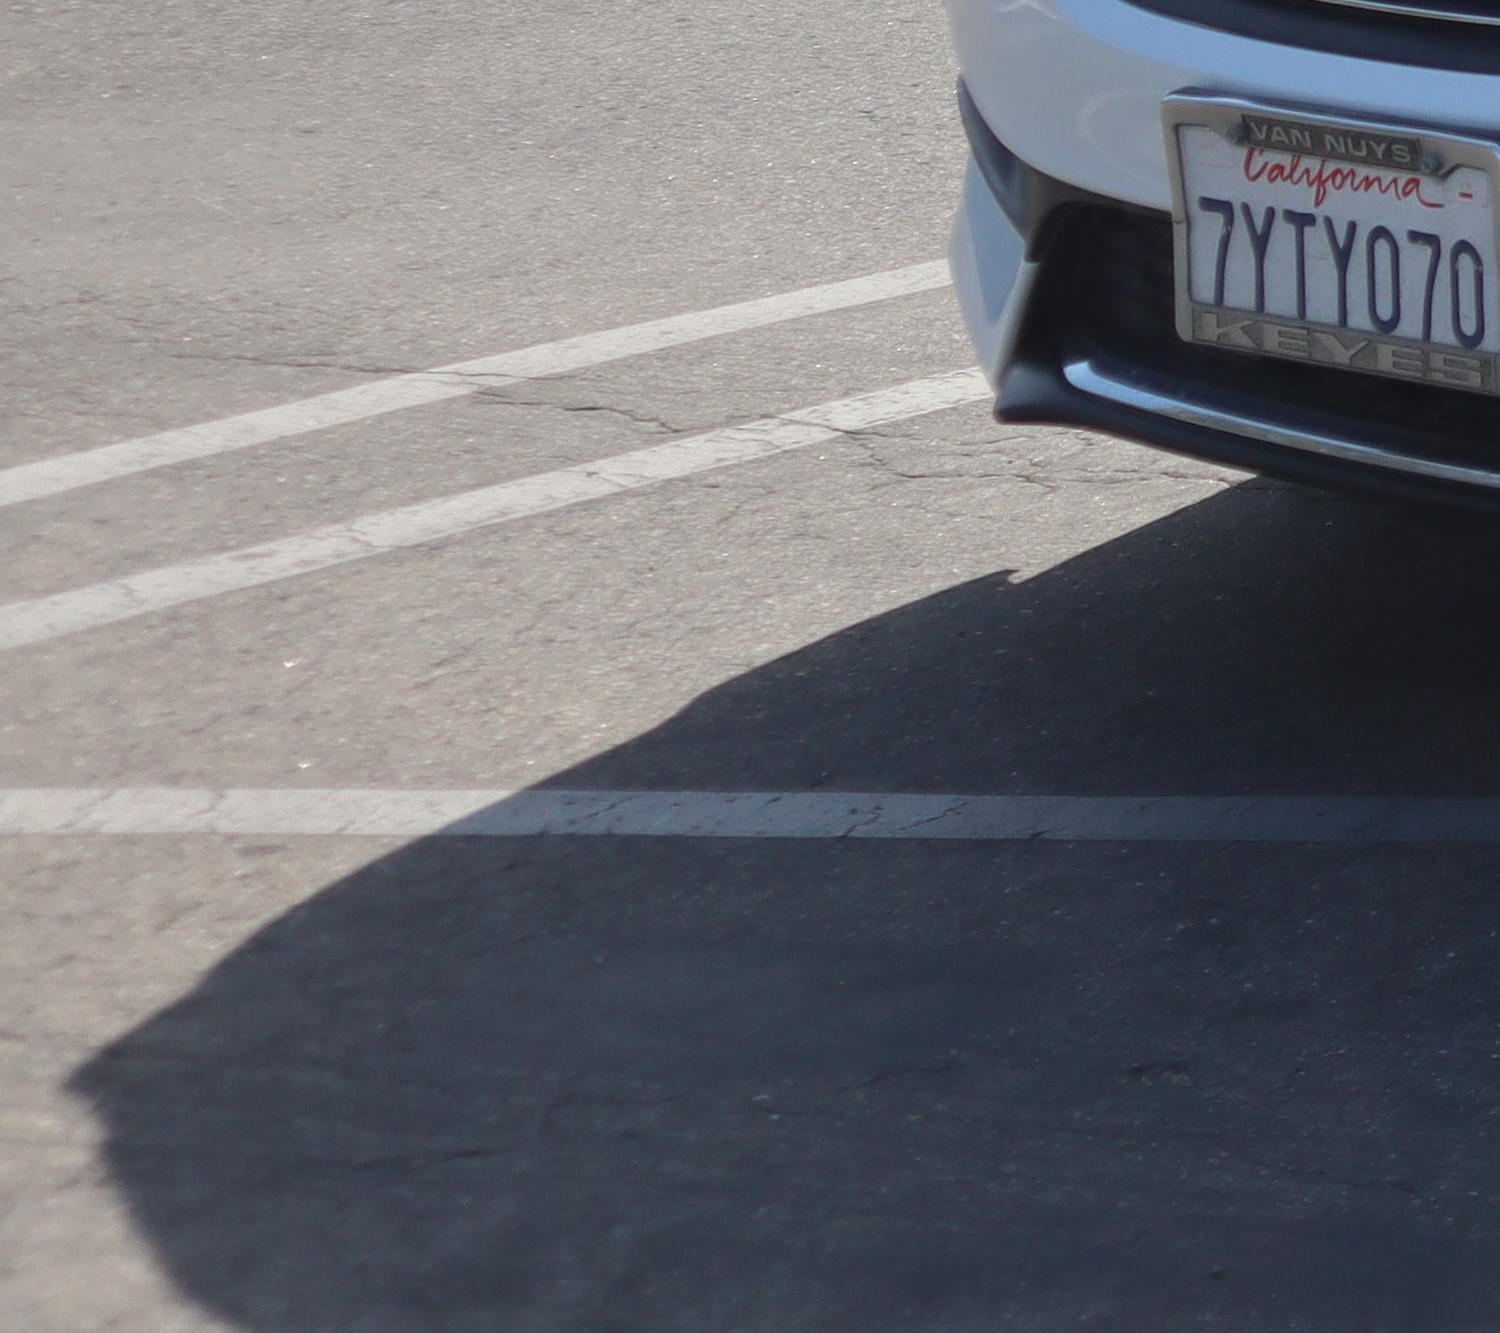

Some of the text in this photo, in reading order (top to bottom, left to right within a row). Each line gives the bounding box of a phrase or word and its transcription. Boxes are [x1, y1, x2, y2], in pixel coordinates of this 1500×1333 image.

[1250, 121, 1412, 164] VAN NUYS
[1243, 147, 1445, 208] California
[1197, 195, 1486, 349] 7YTY070
[1199, 310, 1483, 388] KEYES
